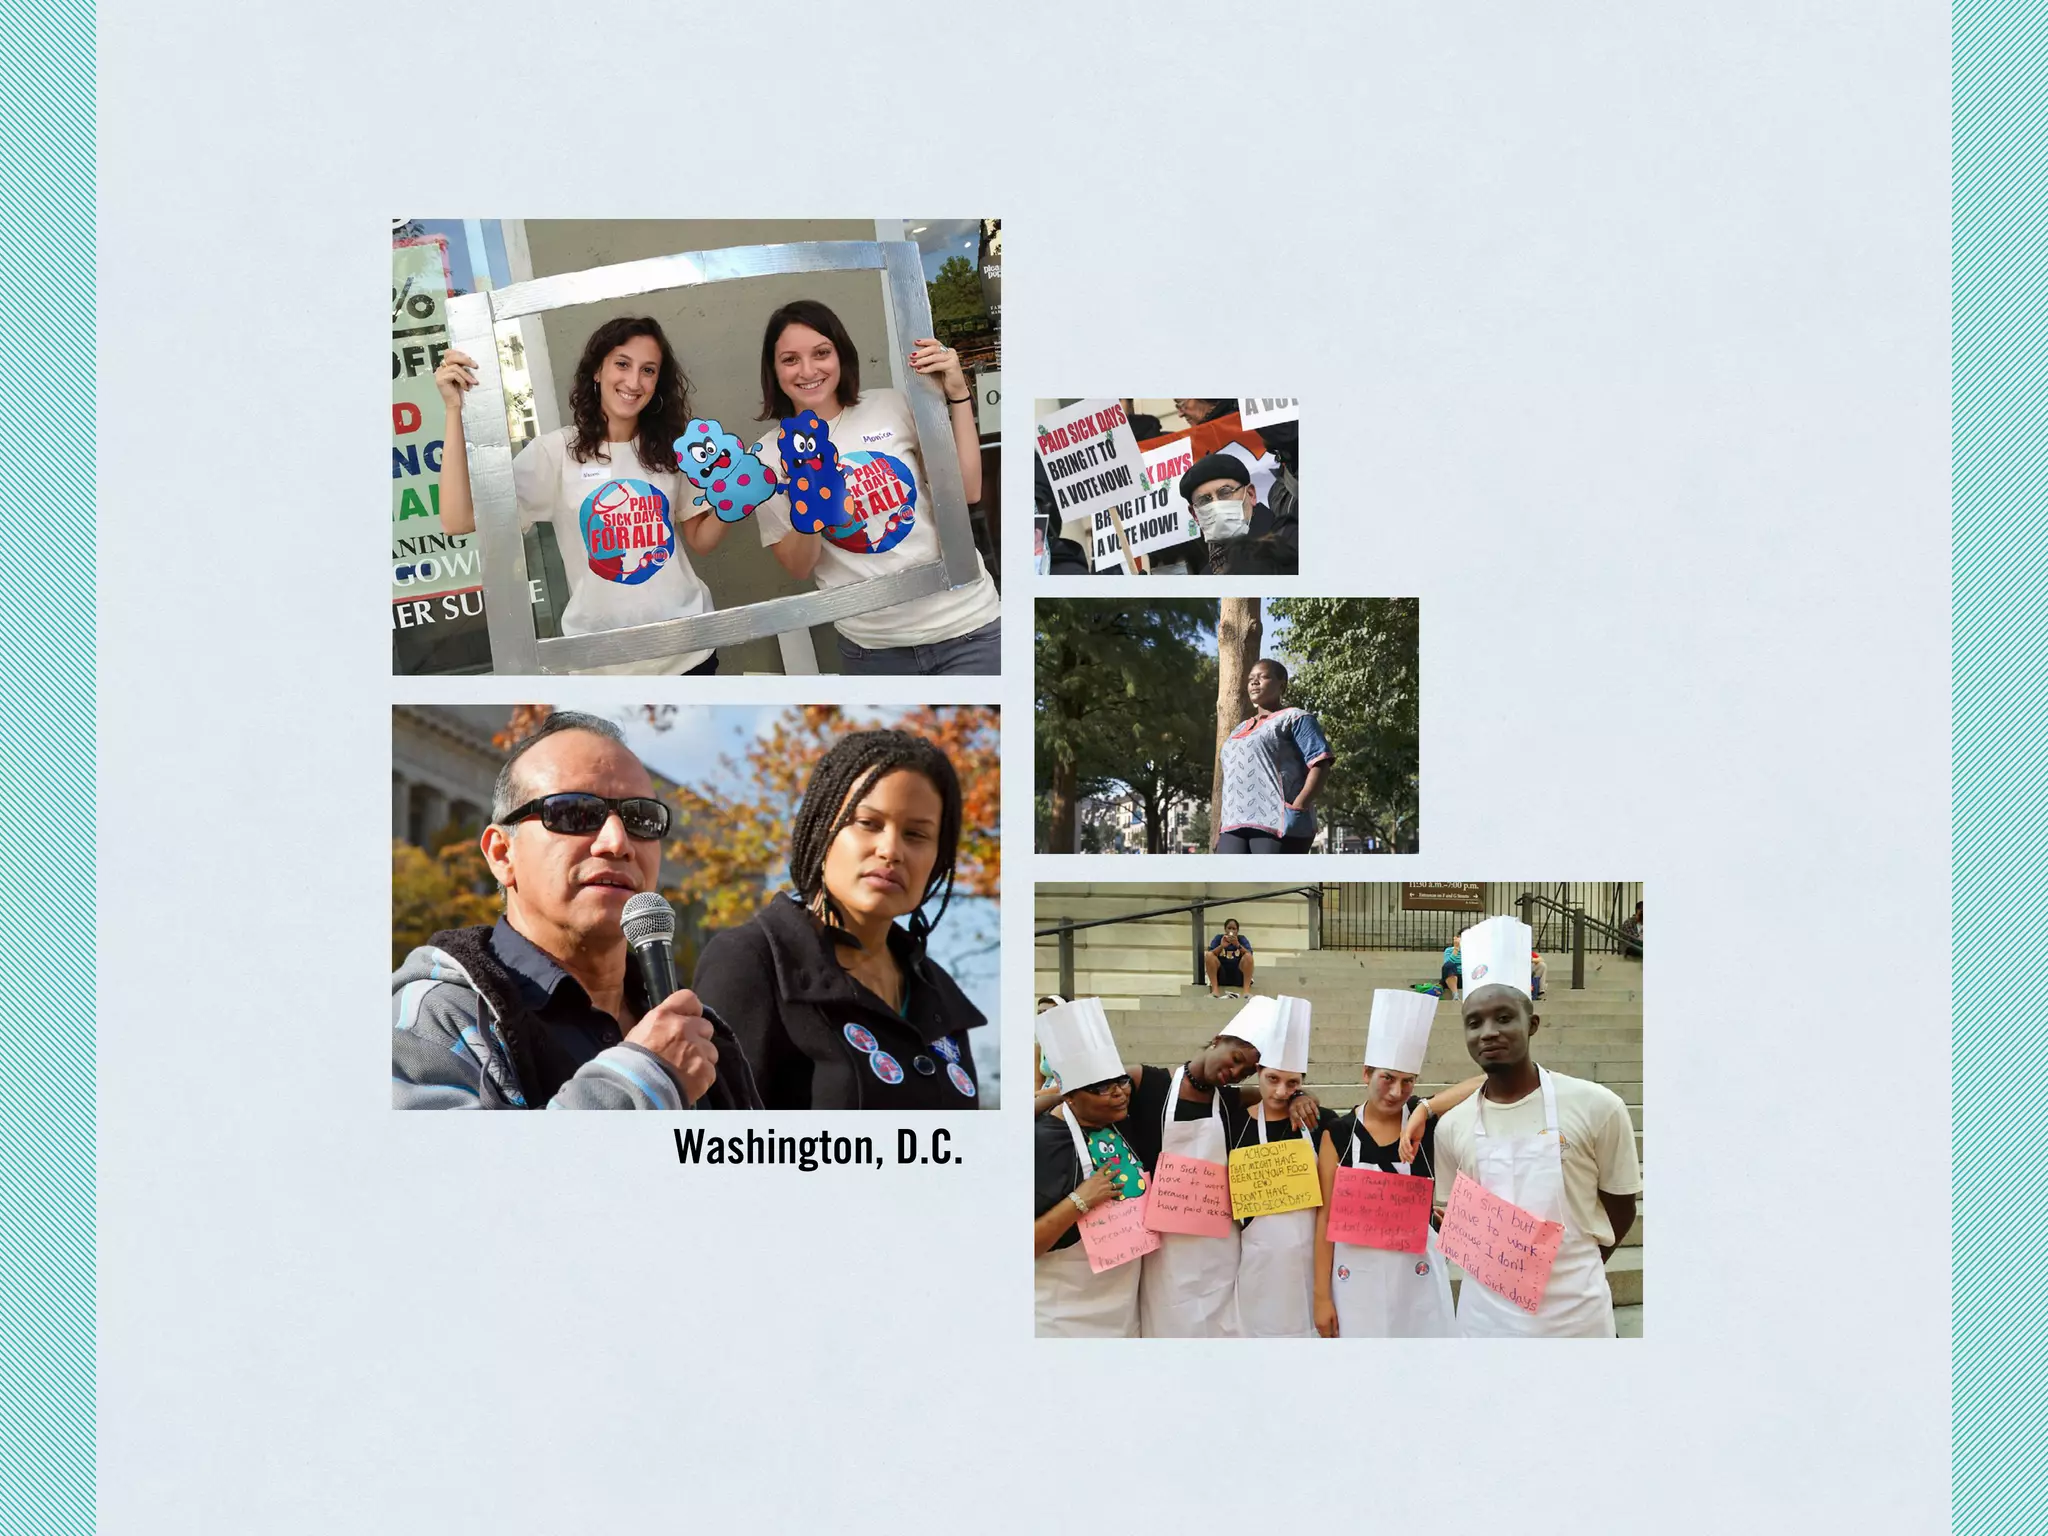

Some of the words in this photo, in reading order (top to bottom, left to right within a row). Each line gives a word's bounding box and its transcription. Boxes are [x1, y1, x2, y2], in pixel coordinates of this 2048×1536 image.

[986, 390, 1001, 405] O
[862, 432, 893, 443] Monica
[1037, 427, 1070, 456] PAID
[1067, 415, 1099, 444] SICK
[1095, 403, 1127, 433] DAYS
[853, 457, 891, 482] PAID
[1047, 449, 1088, 481] BRING
[1085, 445, 1099, 467] IT
[1097, 438, 1117, 462] TO
[1157, 453, 1193, 482] DAYS
[862, 468, 898, 492] DAYS
[1057, 488, 1070, 509] A
[1066, 477, 1101, 505] VOTE
[1097, 464, 1133, 495] NOW!
[630, 495, 663, 511] PAID
[868, 480, 908, 515] ALL
[1095, 499, 1132, 531] BRNG
[1134, 495, 1147, 515] IT
[1149, 487, 1169, 510] TO
[603, 513, 632, 527] SICK
[634, 510, 663, 524] DAYS
[393, 532, 468, 560] NING
[591, 526, 630, 554] FOR
[633, 523, 667, 548] ALL
[1097, 538, 1106, 557] A
[1139, 512, 1179, 541] NOW!
[1230, 1164, 1248, 1175] THAT
[1249, 1159, 1272, 1170] MIGHT
[1275, 1152, 1298, 1168] HAVE
[1254, 1170, 1265, 1181] IN
[1264, 1167, 1285, 1180] YOUR
[1286, 1163, 1309, 1174] FOOD
[1158, 1187, 1189, 1201] because
[1233, 1201, 1262, 1214] PAID
[1263, 1197, 1288, 1210] SICK
[1288, 1191, 1312, 1206] DAYS
[1266, 1184, 1288, 1199] HAVE
[1452, 1195, 1481, 1227] have
[1487, 1216, 1500, 1238] to
[1507, 1236, 1538, 1257] work
[1512, 1210, 1537, 1234] but
[1498, 1252, 1527, 1273] don't
[1509, 1288, 1539, 1312] days
